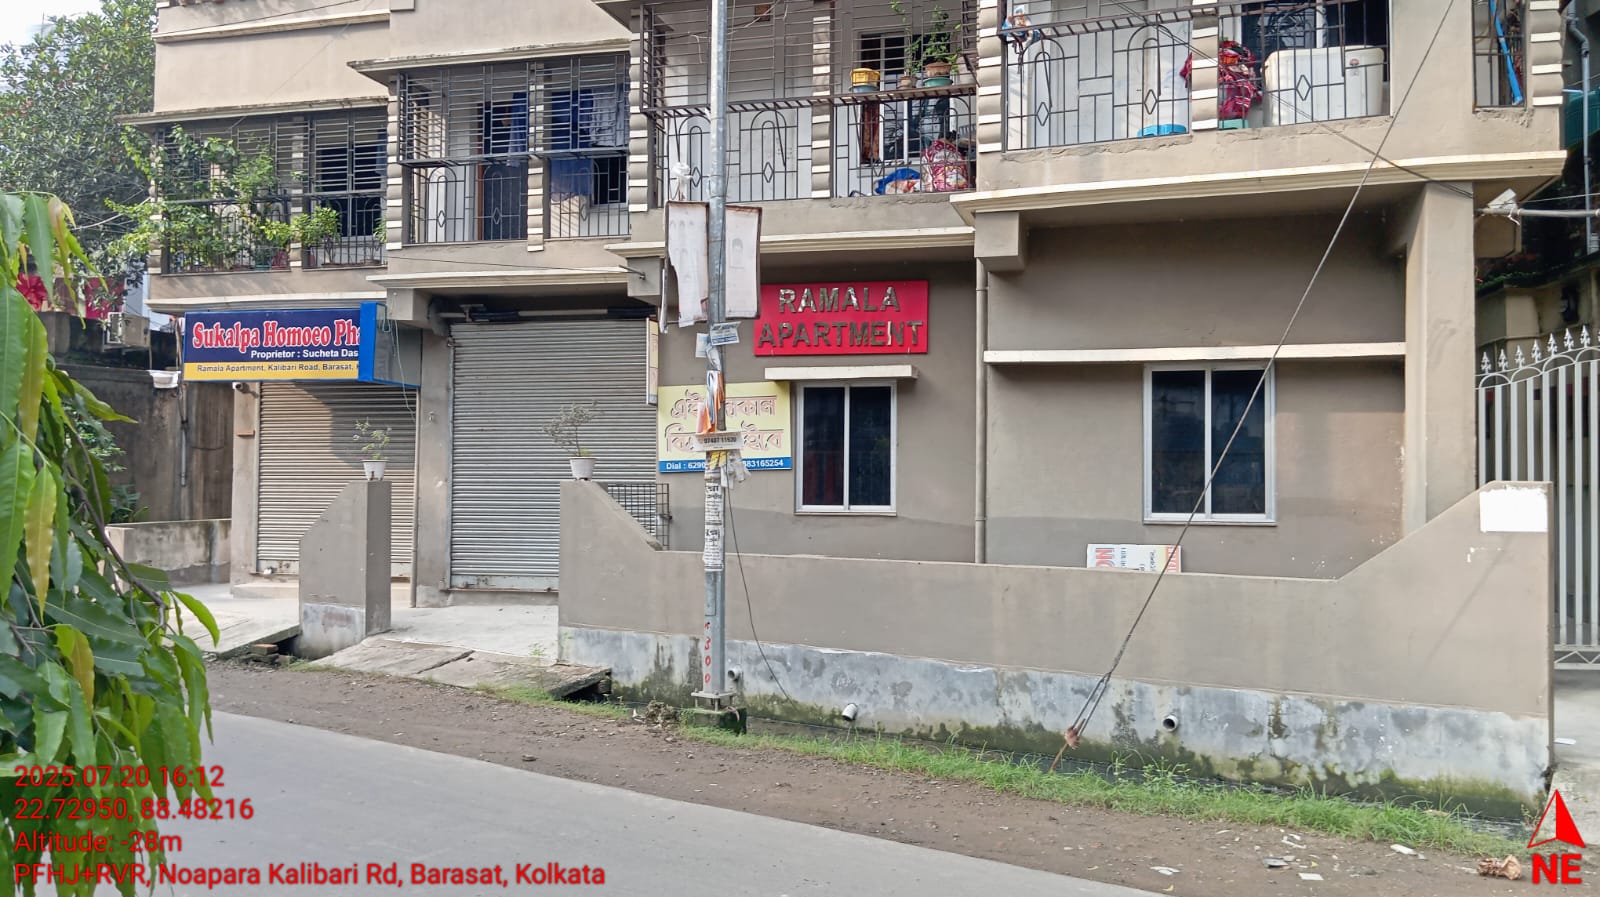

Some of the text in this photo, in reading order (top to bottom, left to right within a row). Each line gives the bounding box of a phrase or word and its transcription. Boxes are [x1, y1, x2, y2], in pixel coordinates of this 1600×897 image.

[779, 286, 900, 313] RAMALA
[193, 321, 260, 353] Sukalpa
[263, 320, 332, 347] Homoeo
[757, 321, 924, 348] APARTMENT
[251, 350, 295, 360] Proprietor
[302, 349, 339, 358] Sucheta
[341, 348, 359, 357] Das
[666, 462, 682, 470] Dial
[688, 461, 706, 469] 6290
